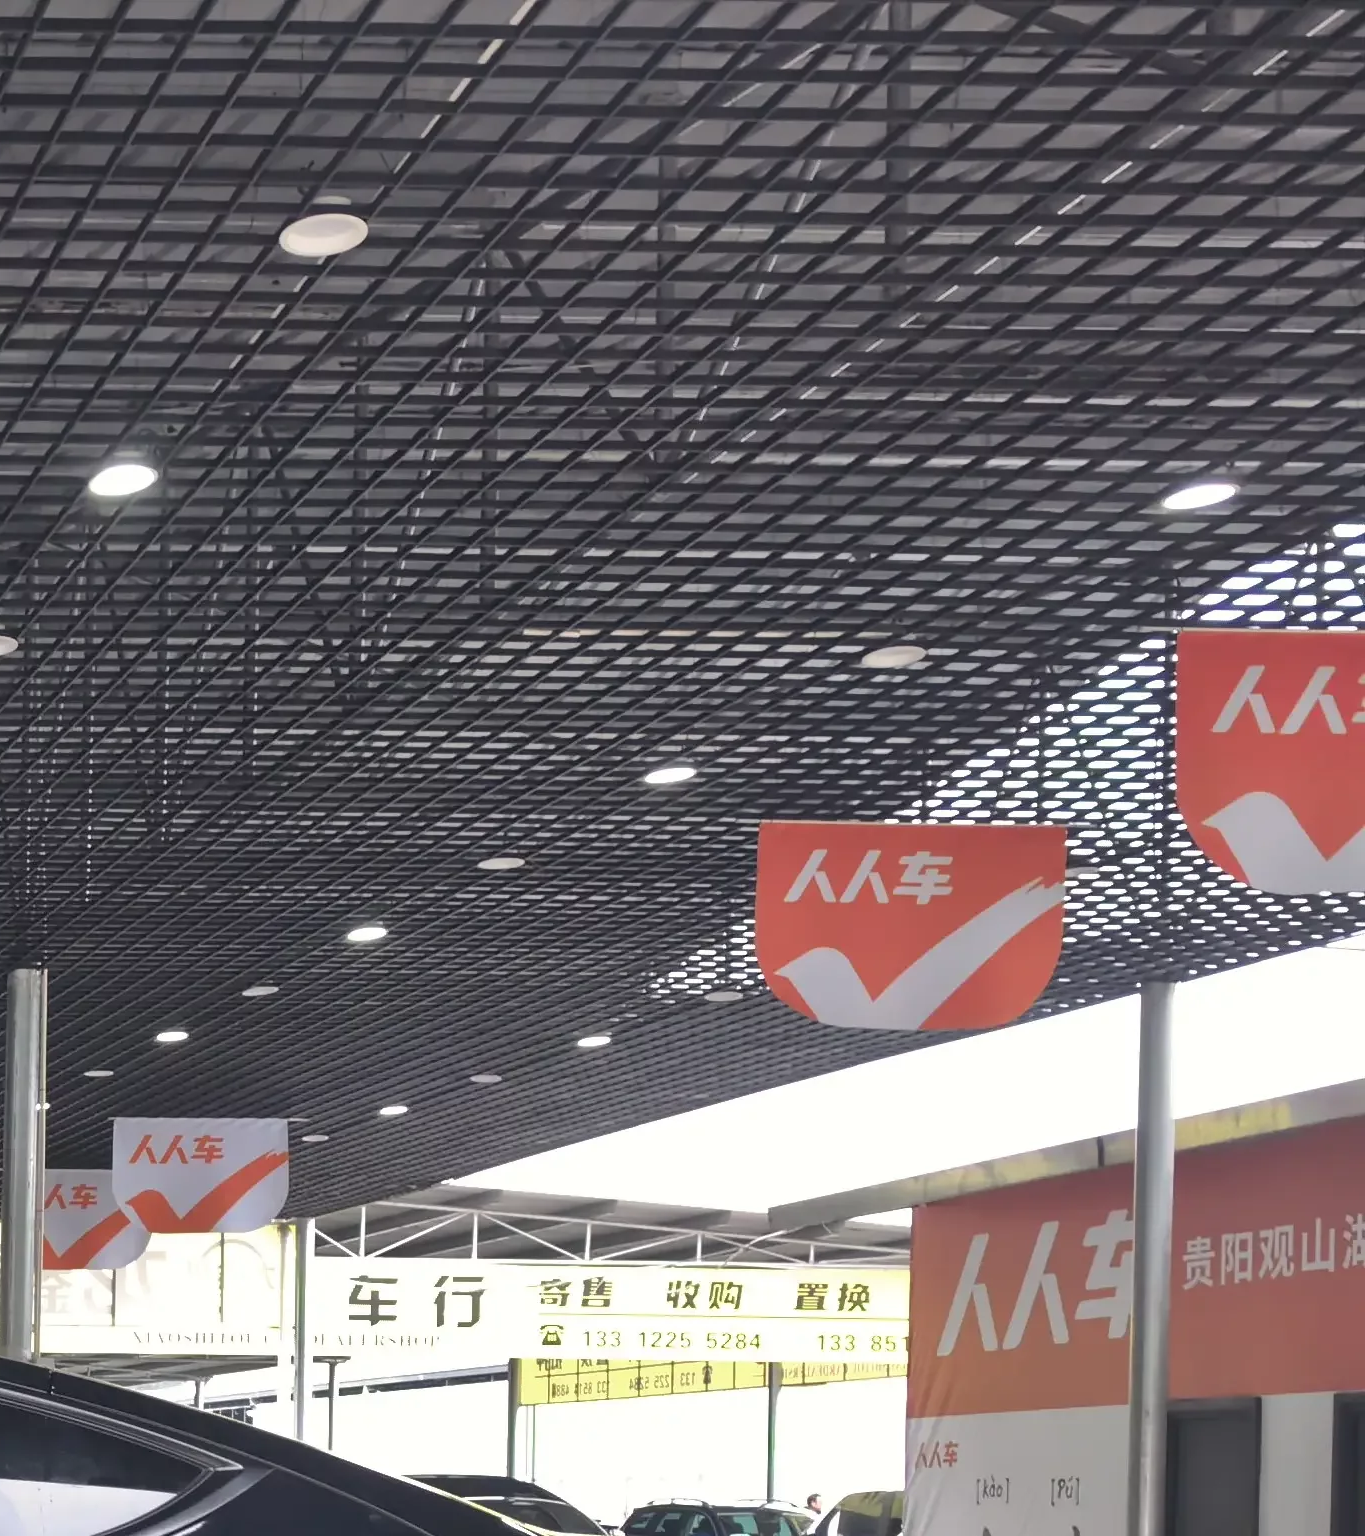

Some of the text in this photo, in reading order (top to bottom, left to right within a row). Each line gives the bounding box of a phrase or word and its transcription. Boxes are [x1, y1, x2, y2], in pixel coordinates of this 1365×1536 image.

[1212, 664, 1365, 735] 人人
[783, 849, 953, 905] 人人车
[129, 1135, 224, 1165] 人人车
[348, 1275, 486, 1327] 车行
[537, 1276, 871, 1311] 寄售 收购 置换
[937, 1209, 1135, 1357] 人人车
[583, 1331, 621, 1348] 133
[638, 1331, 692, 1348] 1225
[706, 1332, 761, 1349] 5284
[817, 1334, 856, 1351] 133
[915, 1440, 959, 1468] 人人车
